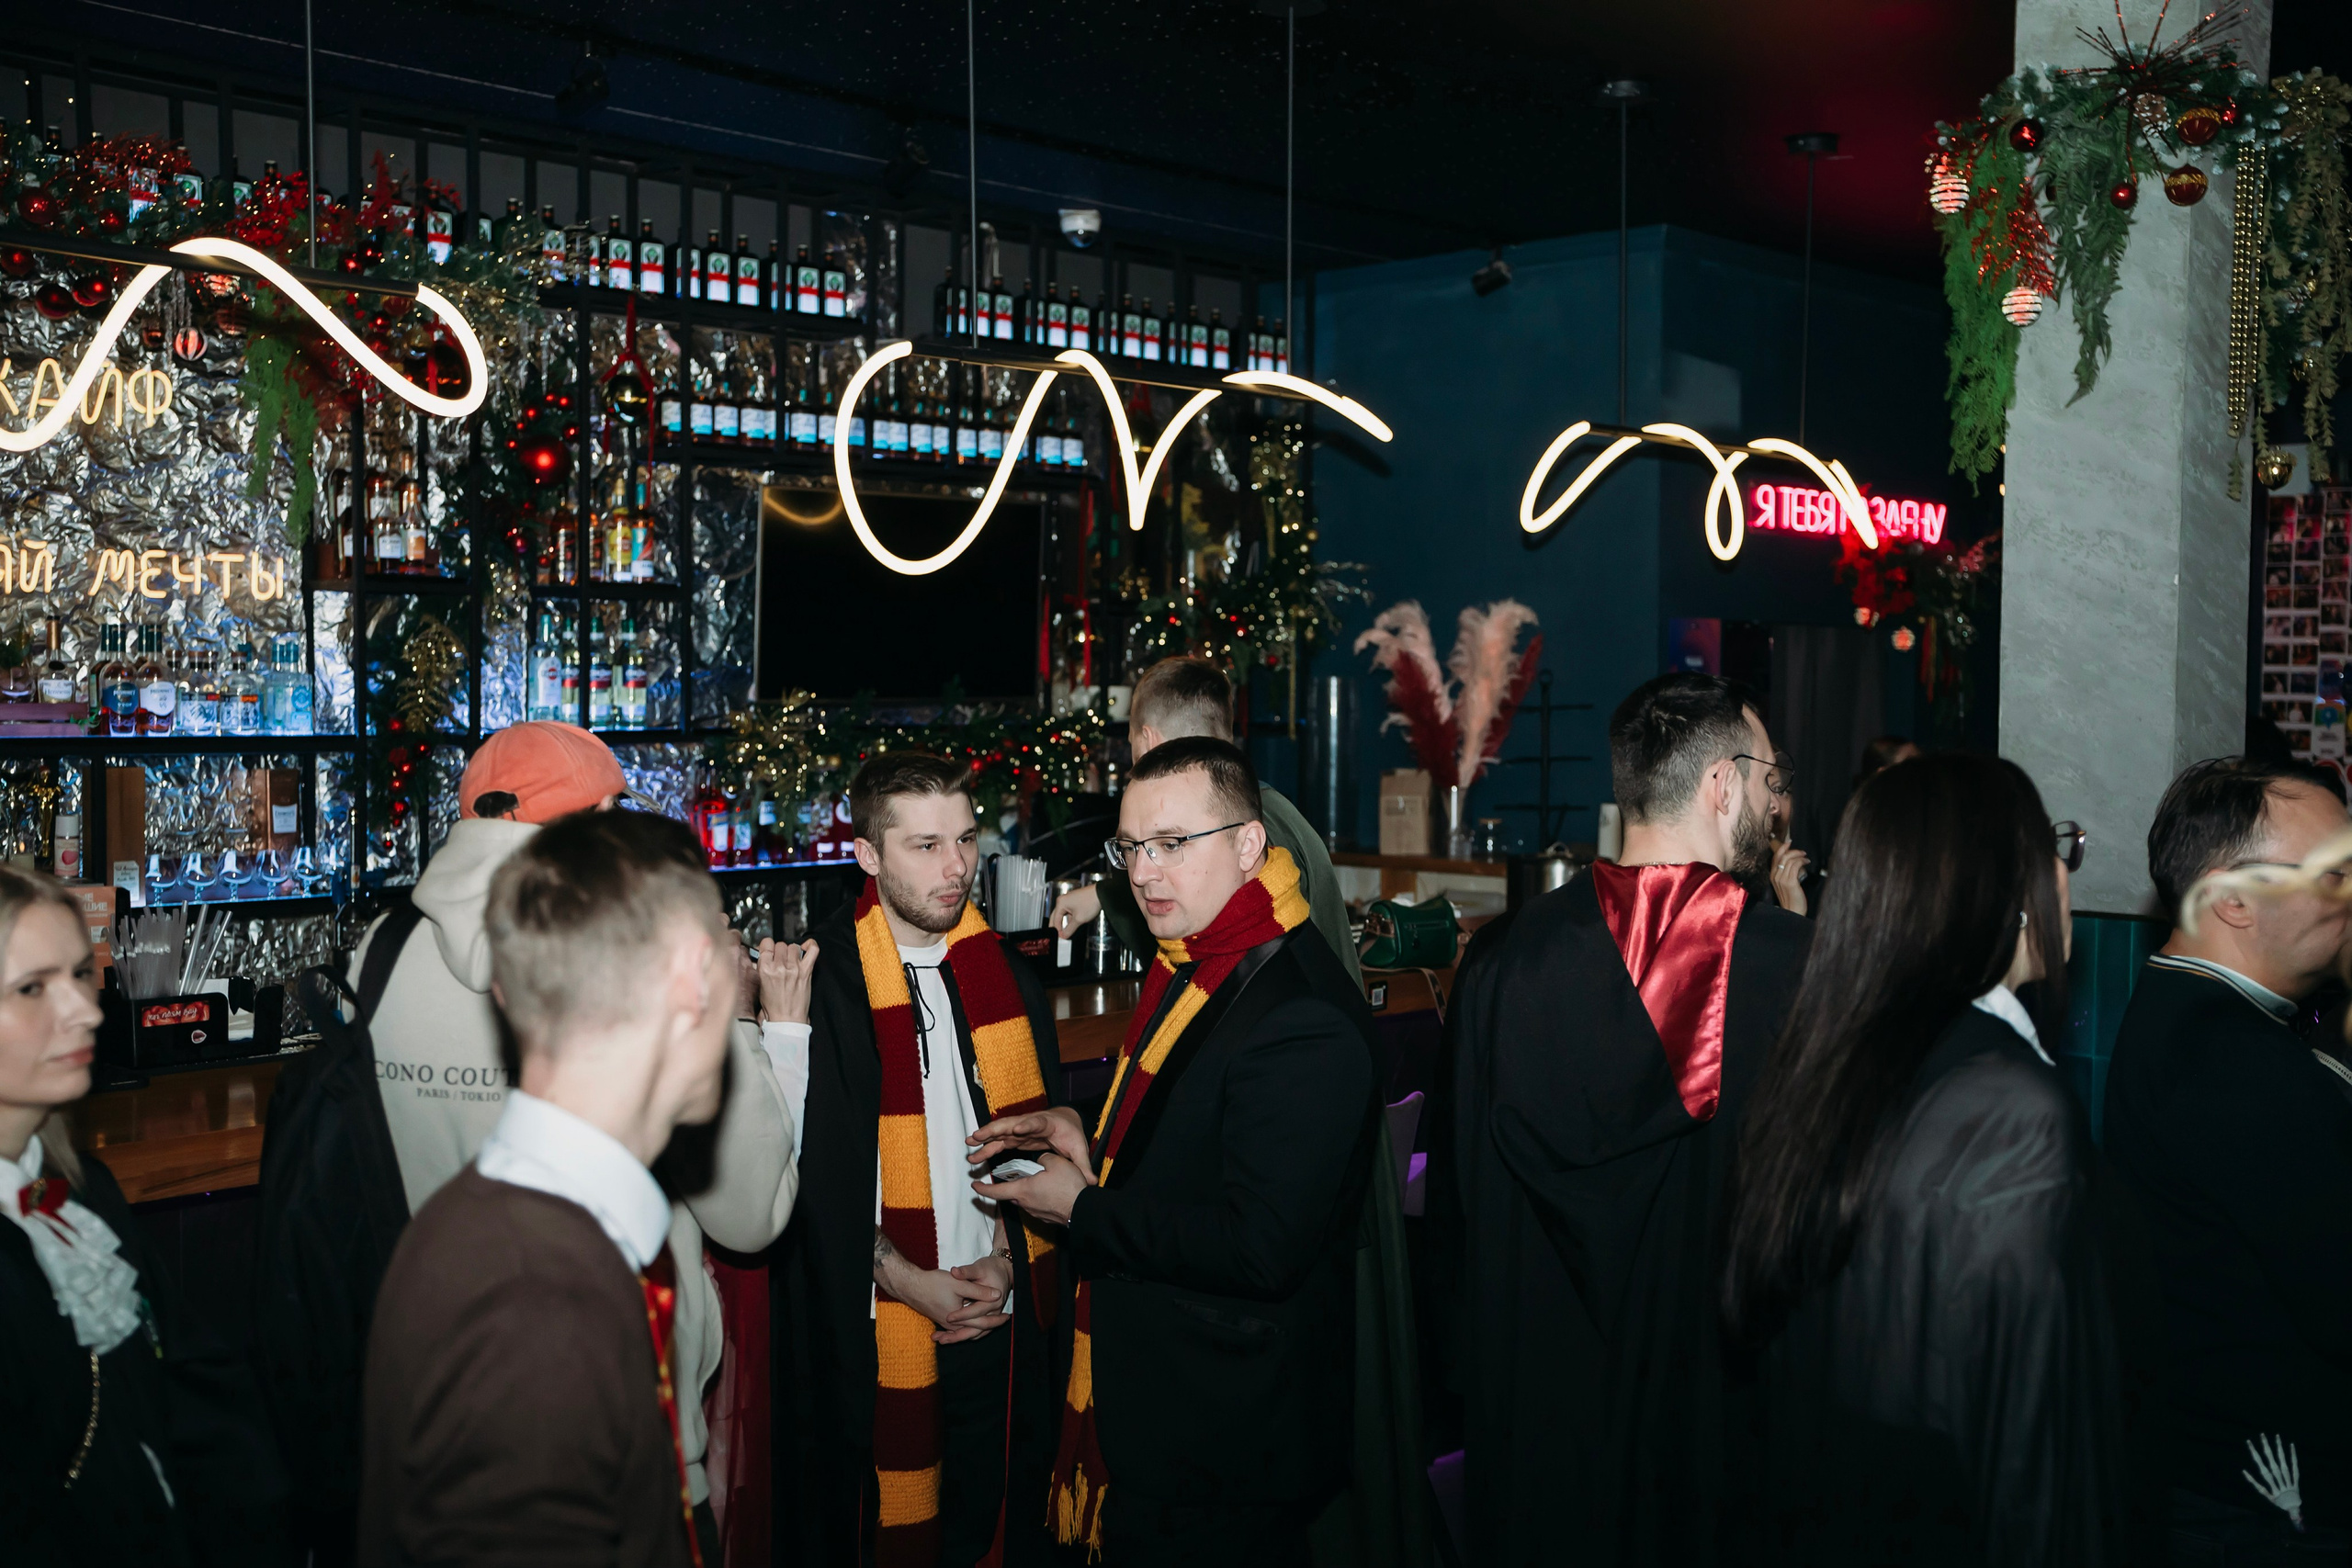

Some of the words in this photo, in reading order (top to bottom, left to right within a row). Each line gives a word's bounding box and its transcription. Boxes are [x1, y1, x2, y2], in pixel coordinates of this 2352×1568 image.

[1754, 484, 1776, 530] Я
[1778, 486, 1837, 535] ТЕБЯ
[88, 548, 284, 601] МЕЧТЫ
[416, 1088, 449, 1099] PARIS
[460, 1091, 501, 1102] TOKIO
